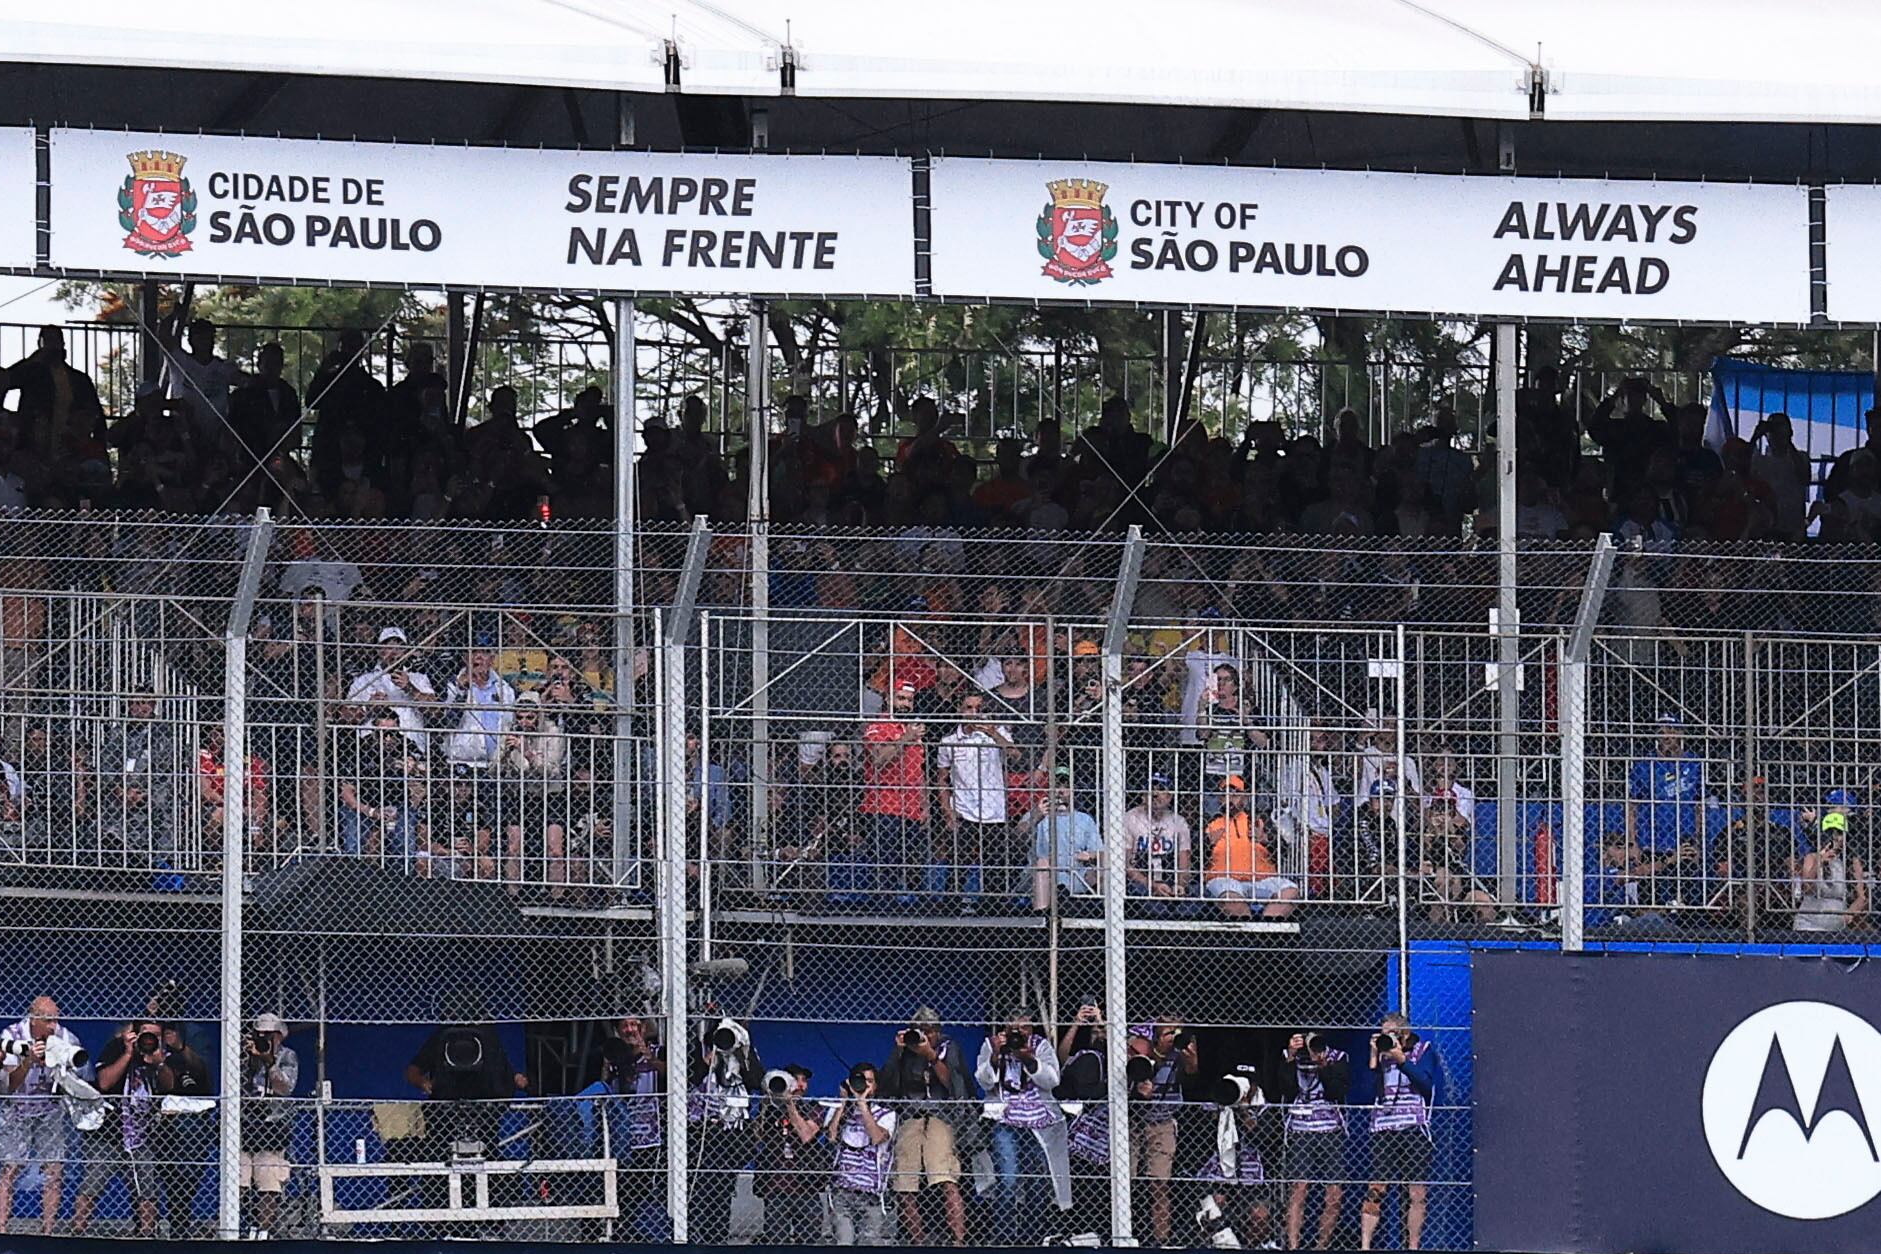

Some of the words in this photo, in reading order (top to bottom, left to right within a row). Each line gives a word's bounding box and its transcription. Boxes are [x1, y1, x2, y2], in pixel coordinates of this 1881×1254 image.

[208, 171, 331, 204] CIDADE
[342, 178, 384, 206] DE
[565, 174, 757, 217] SEMPRE
[209, 204, 295, 247] SÃO
[305, 215, 442, 252] PAULO
[1130, 199, 1205, 228] CITY
[1214, 202, 1258, 230] OF
[1493, 201, 1698, 246] ALWAYS
[567, 226, 642, 266] NA
[662, 229, 839, 270] FRENTE
[1130, 231, 1219, 272] SÃO
[1229, 241, 1369, 278] PAULO
[1492, 253, 1670, 295] AHEAD
